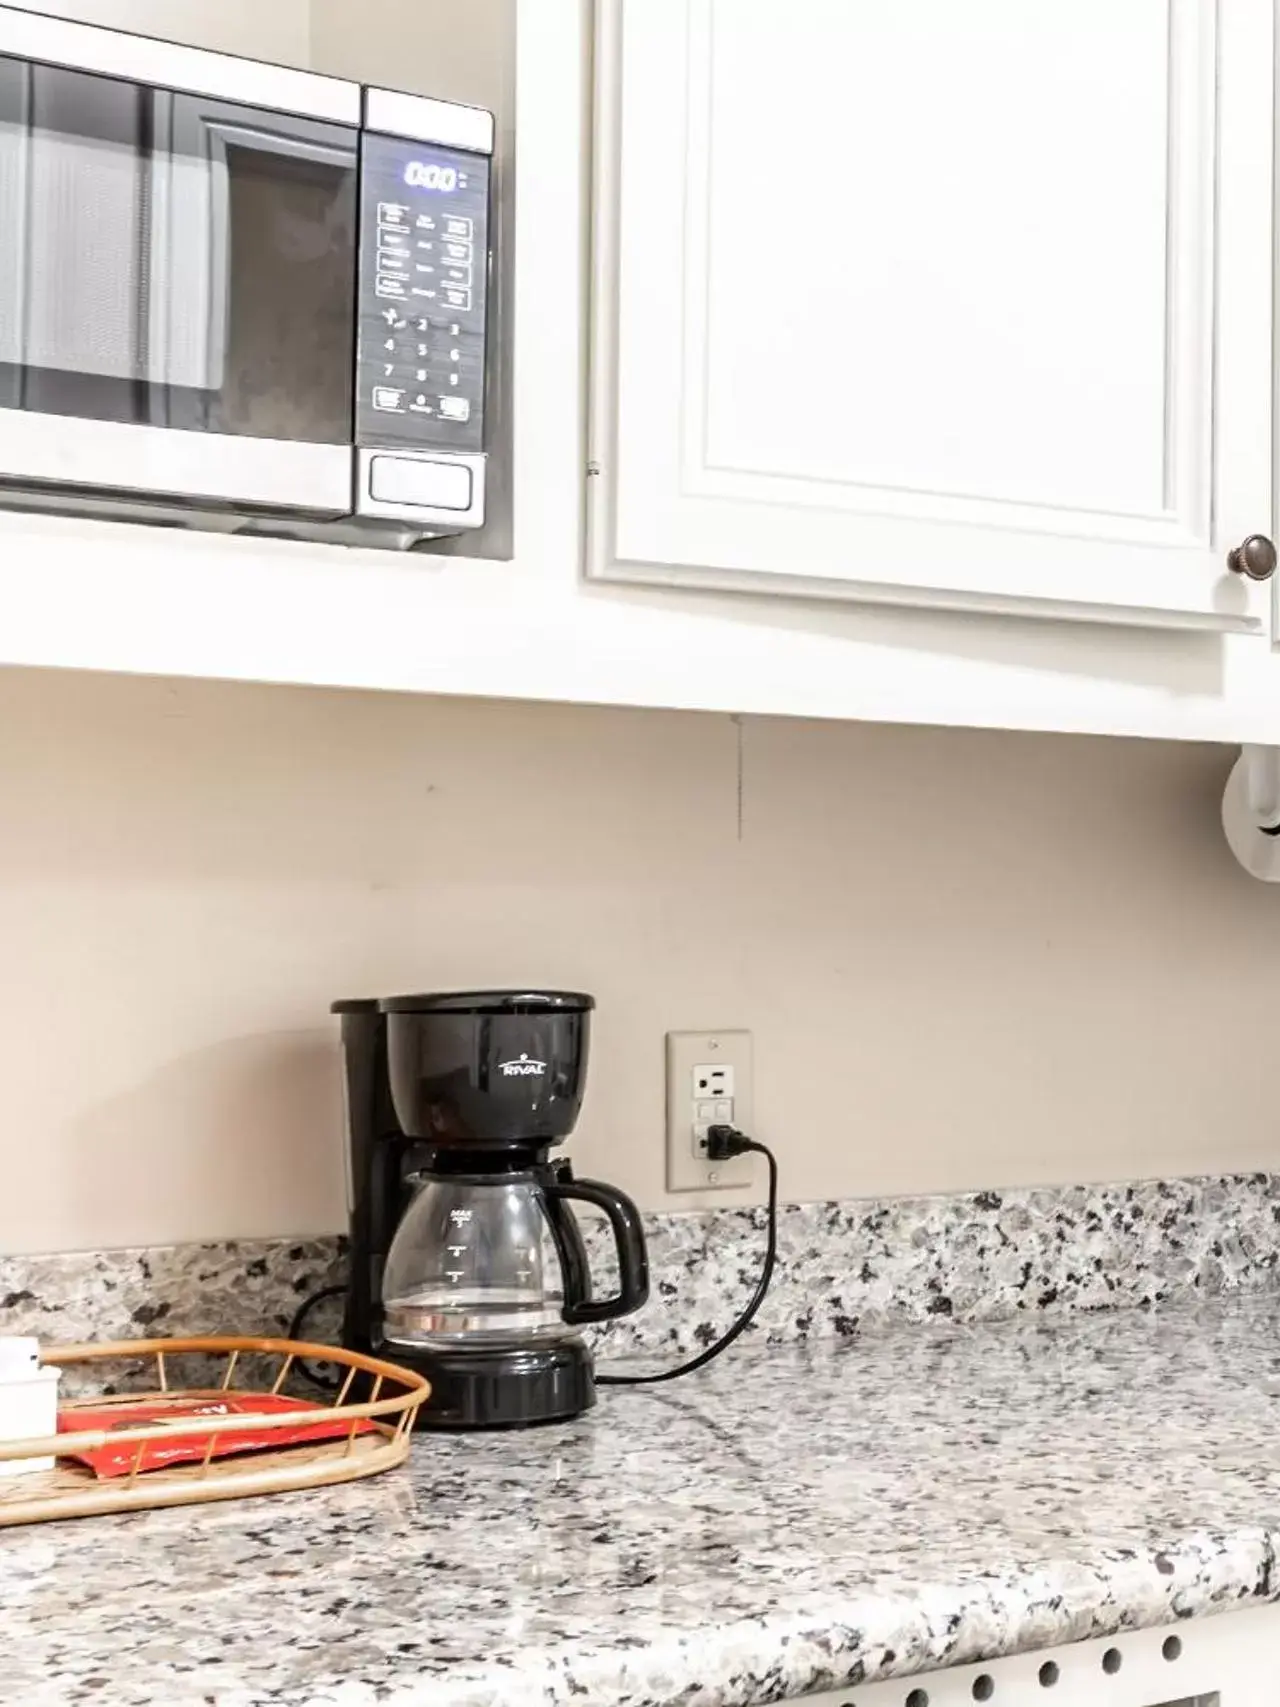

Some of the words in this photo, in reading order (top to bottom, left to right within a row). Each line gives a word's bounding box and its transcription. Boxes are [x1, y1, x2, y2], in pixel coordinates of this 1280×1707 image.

[417, 319, 428, 331] 2
[384, 339, 394, 351] 4
[450, 349, 460, 361] 6
[384, 364, 394, 376] 7
[503, 1064, 545, 1077] RIVAL
